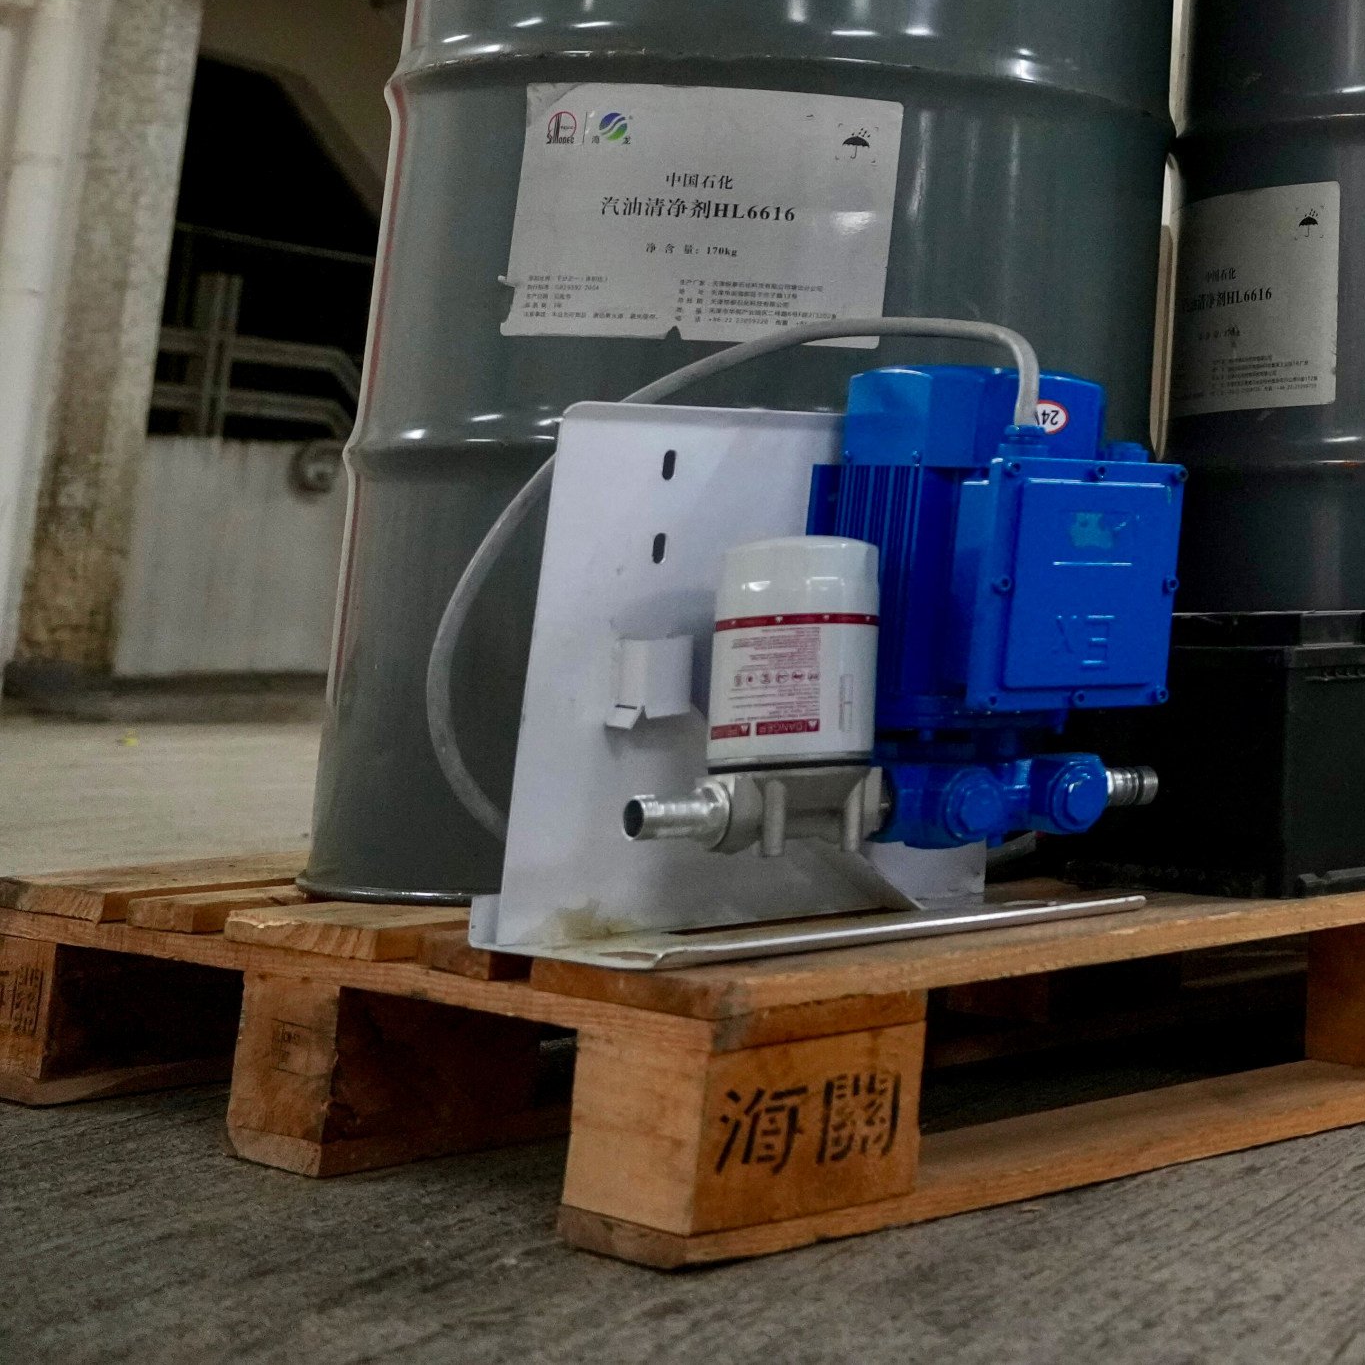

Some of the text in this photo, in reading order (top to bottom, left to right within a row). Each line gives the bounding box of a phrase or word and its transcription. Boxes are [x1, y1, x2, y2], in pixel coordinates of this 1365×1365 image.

[665, 172, 734, 190] 中国石化
[601, 196, 796, 222] 汽油清净剂HL6616
[715, 1072, 901, 1176] 海關
